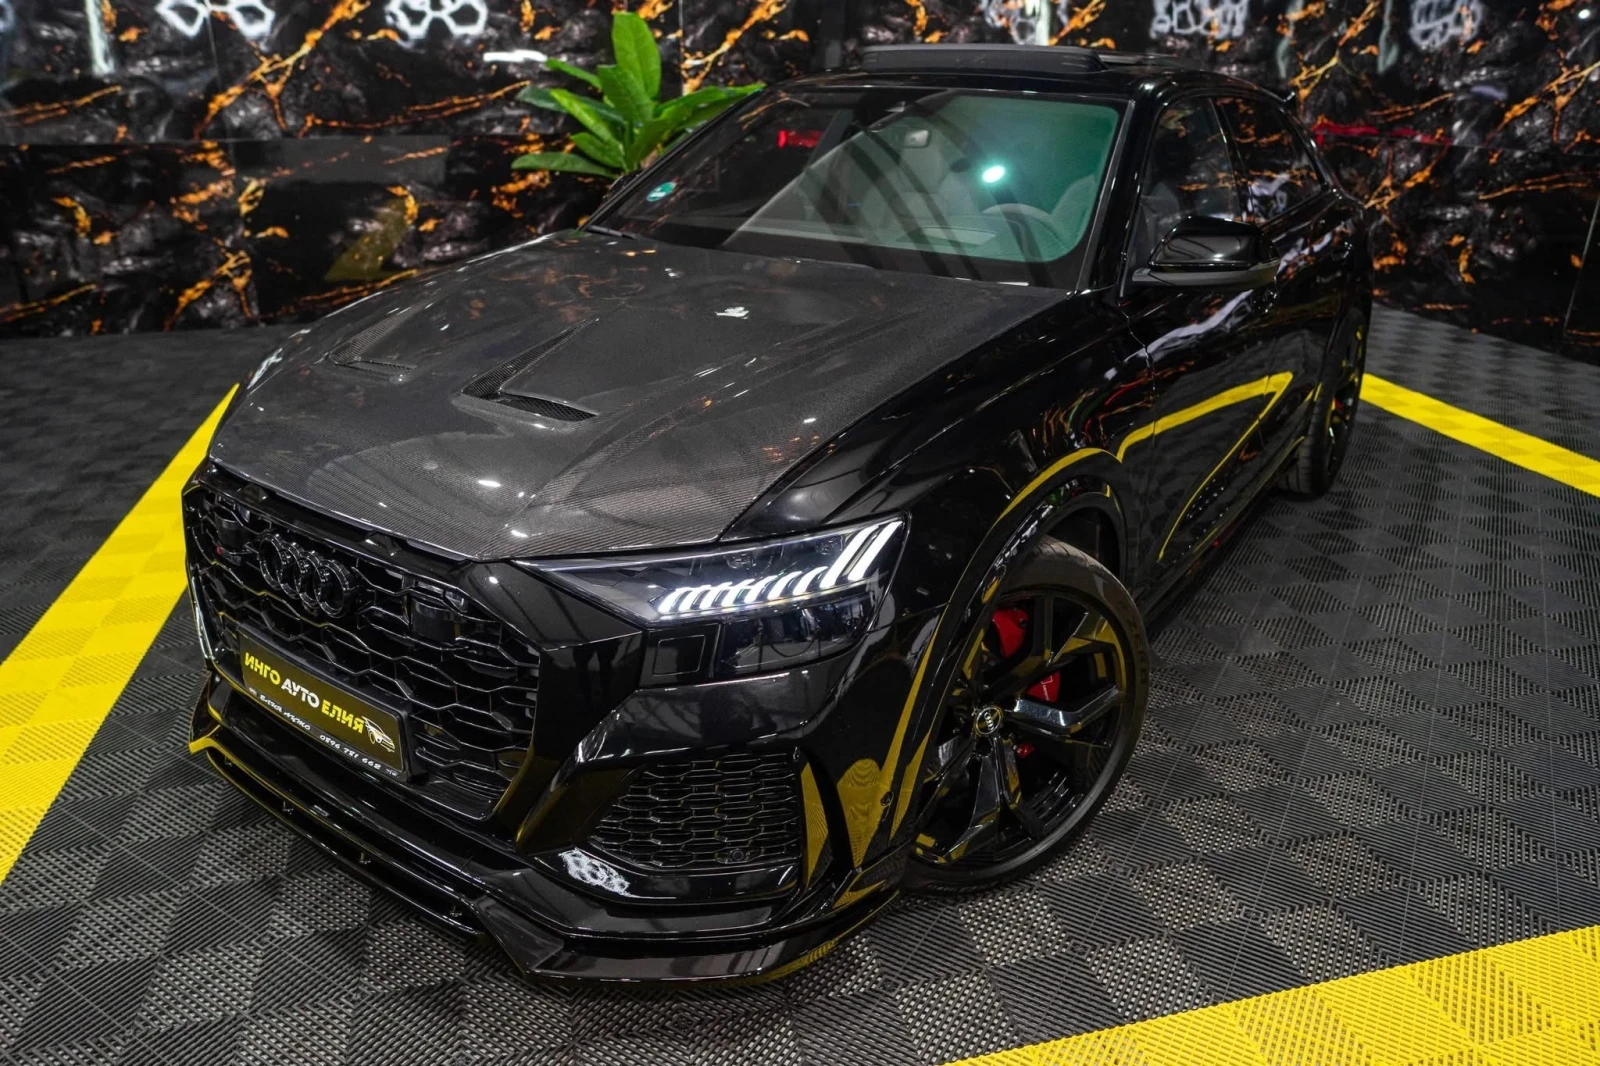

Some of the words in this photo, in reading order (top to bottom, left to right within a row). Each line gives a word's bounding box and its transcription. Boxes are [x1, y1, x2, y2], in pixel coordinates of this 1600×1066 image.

[244, 652, 281, 685] ИНГО
[281, 678, 320, 708] АУТО
[321, 699, 365, 734] ЕЛИЯ
